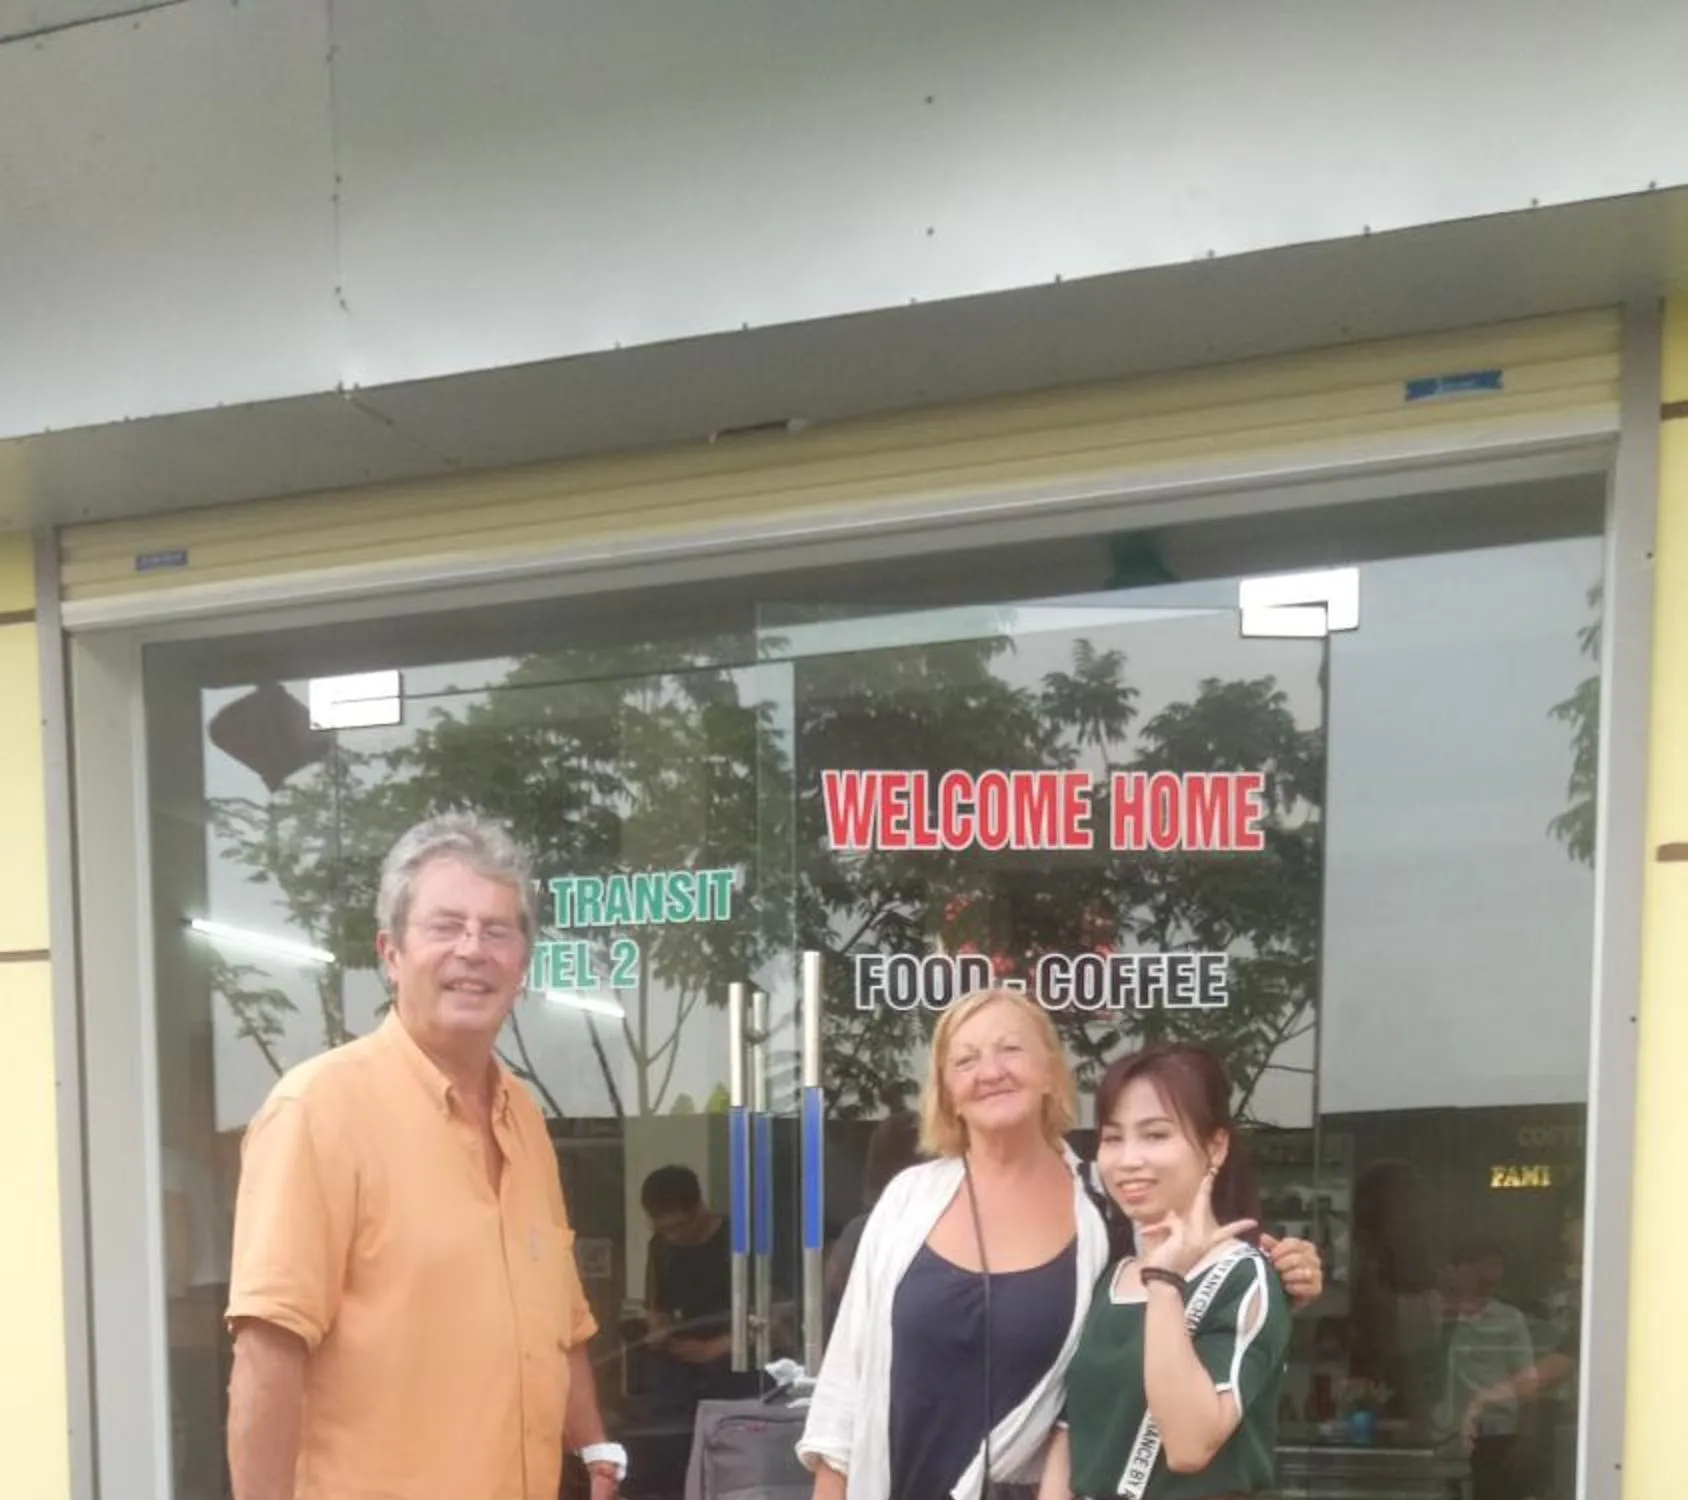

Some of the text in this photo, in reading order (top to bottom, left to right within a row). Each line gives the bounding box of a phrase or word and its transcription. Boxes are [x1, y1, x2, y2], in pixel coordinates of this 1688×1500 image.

[821, 769, 1265, 851] WELCOME HOME
[549, 869, 735, 928] TRANSIT
[530, 938, 640, 991] TEL 2
[855, 953, 994, 1011] FOOD
[1036, 952, 1228, 1010] COFFEE
